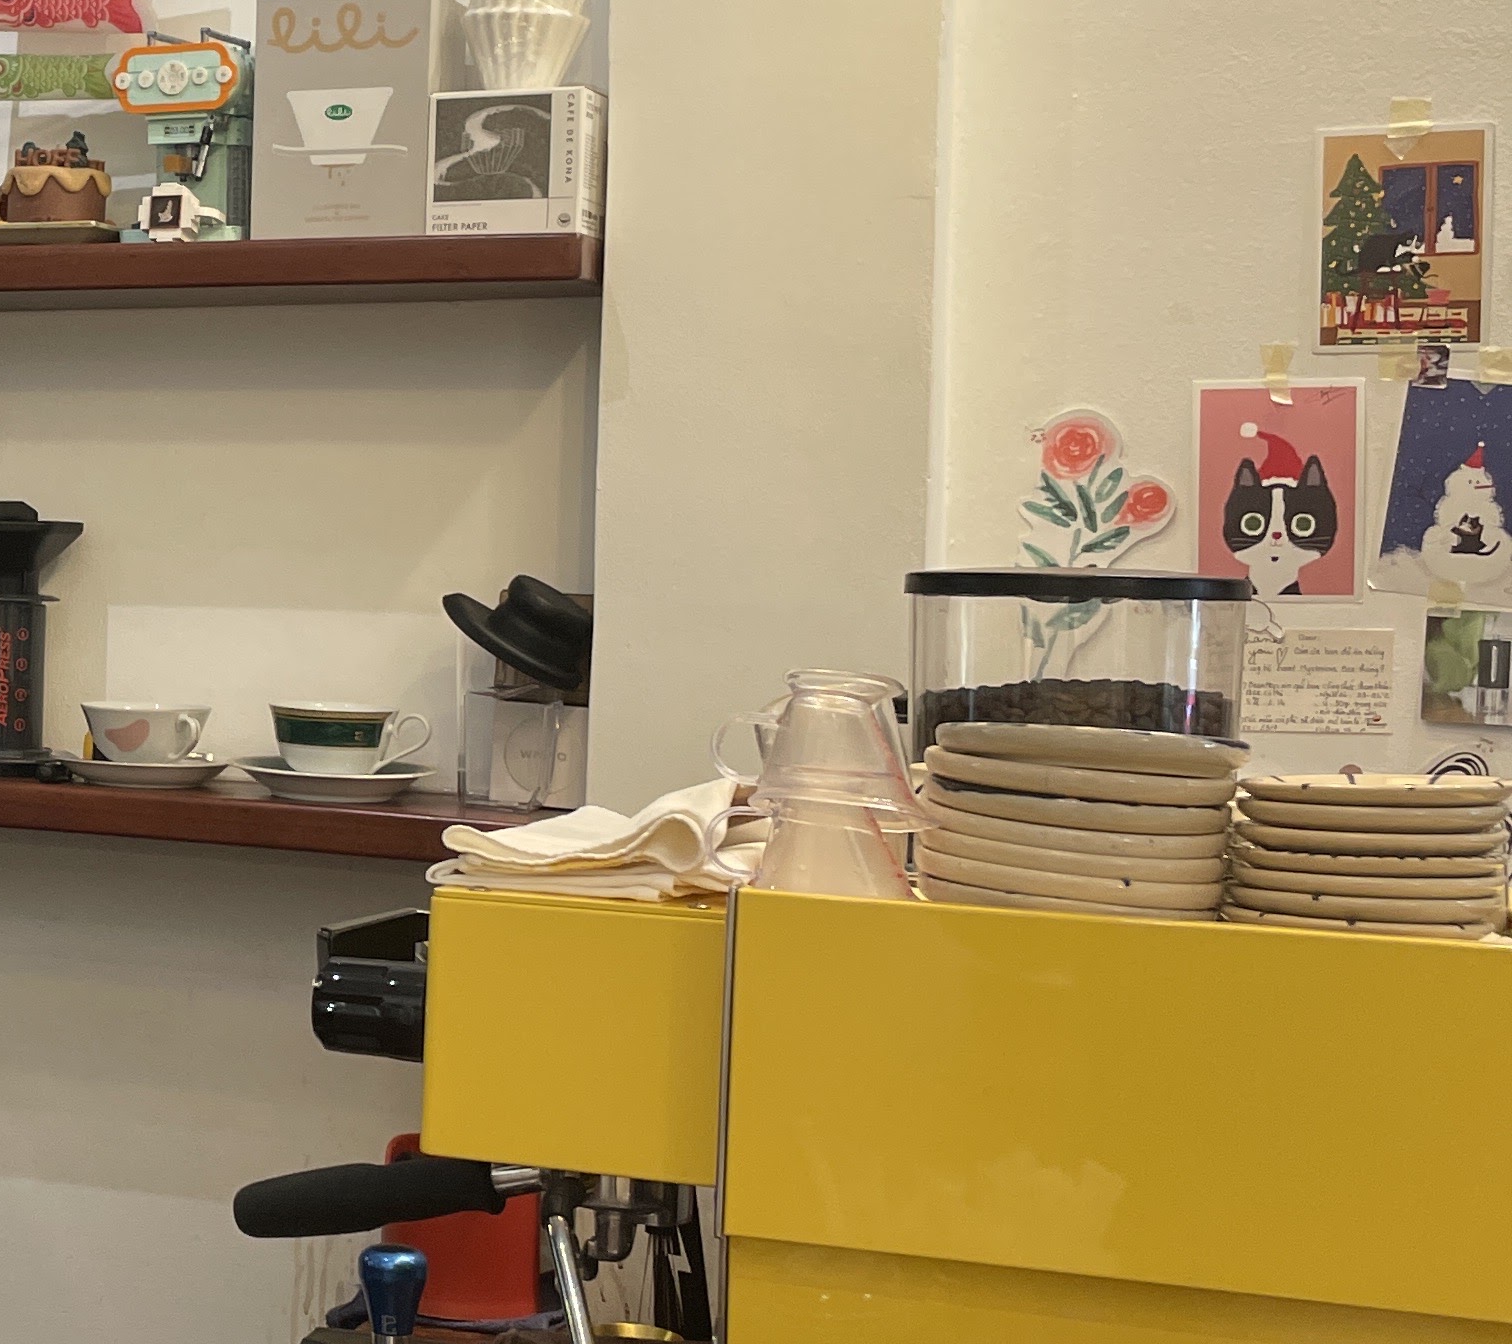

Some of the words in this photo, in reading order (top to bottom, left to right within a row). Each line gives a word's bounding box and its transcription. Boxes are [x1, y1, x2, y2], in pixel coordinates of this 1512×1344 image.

[566, 93, 576, 123] CAFE
[566, 129, 575, 143] DE
[564, 149, 574, 184] KONA
